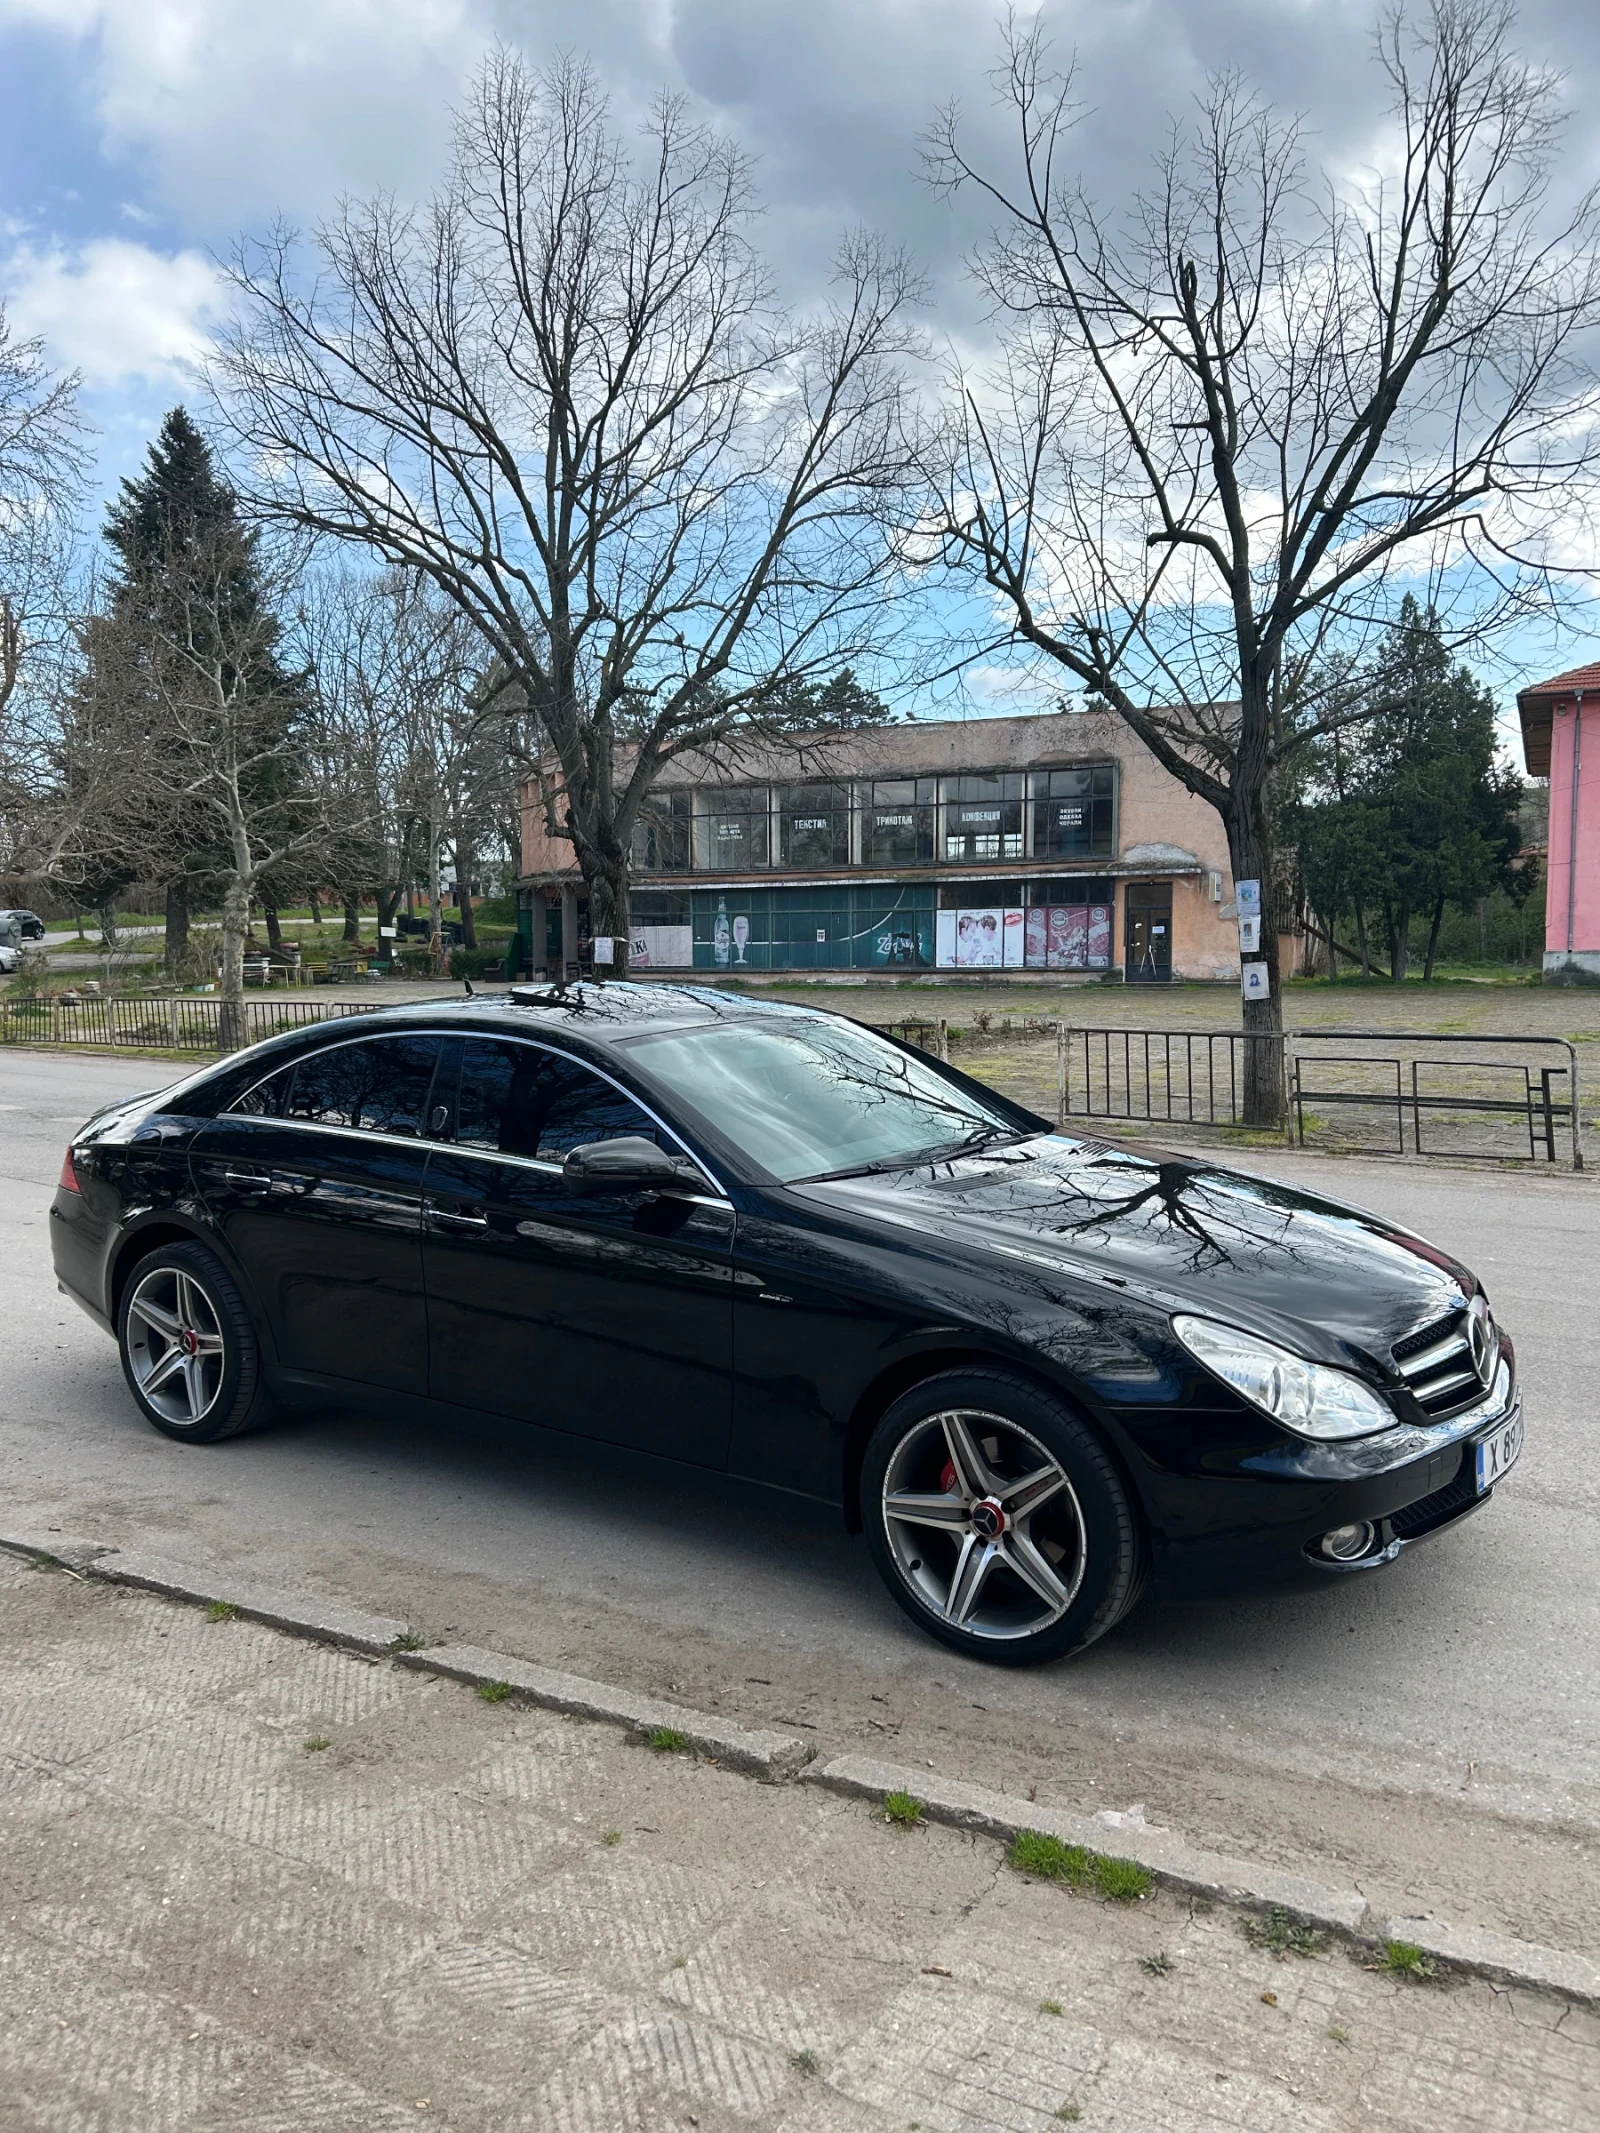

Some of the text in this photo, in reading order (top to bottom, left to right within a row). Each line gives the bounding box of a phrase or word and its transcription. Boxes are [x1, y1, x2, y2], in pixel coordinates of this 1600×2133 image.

[794, 819, 827, 830] ТЕКСТИЛ
[876, 815, 913, 826] ТРИКОТАЖ
[1490, 1438, 1498, 1477] X
